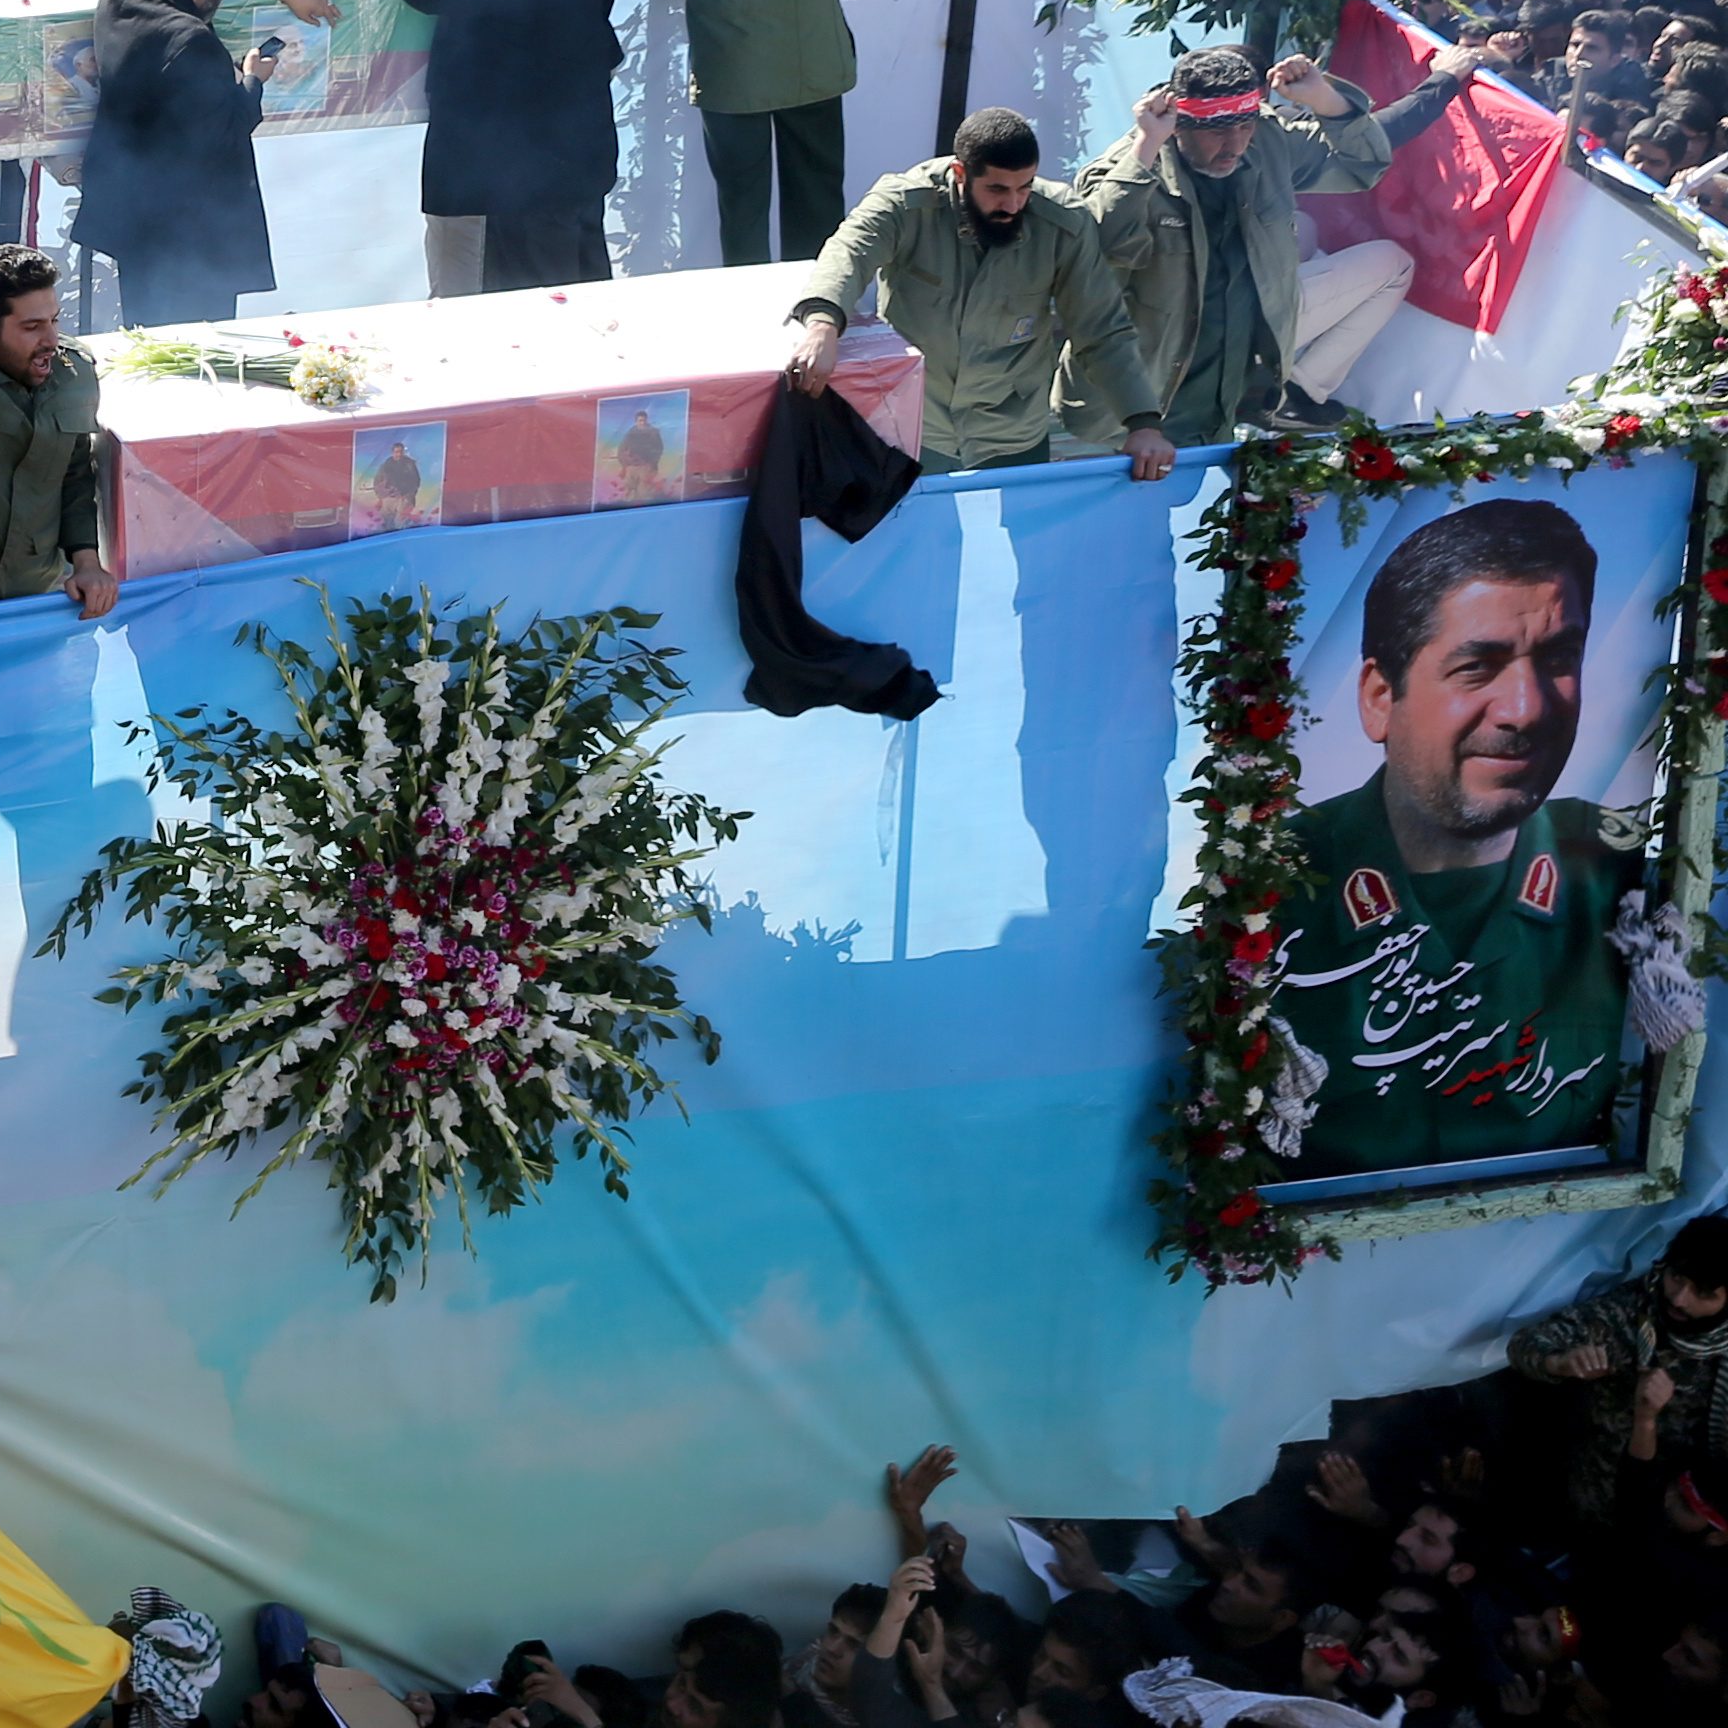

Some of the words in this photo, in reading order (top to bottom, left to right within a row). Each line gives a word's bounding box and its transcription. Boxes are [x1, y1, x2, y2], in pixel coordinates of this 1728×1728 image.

[1362, 960, 1475, 1044] حسین
[1442, 1017, 1539, 1107] شهید
[1506, 1036, 1606, 1118] سردار
